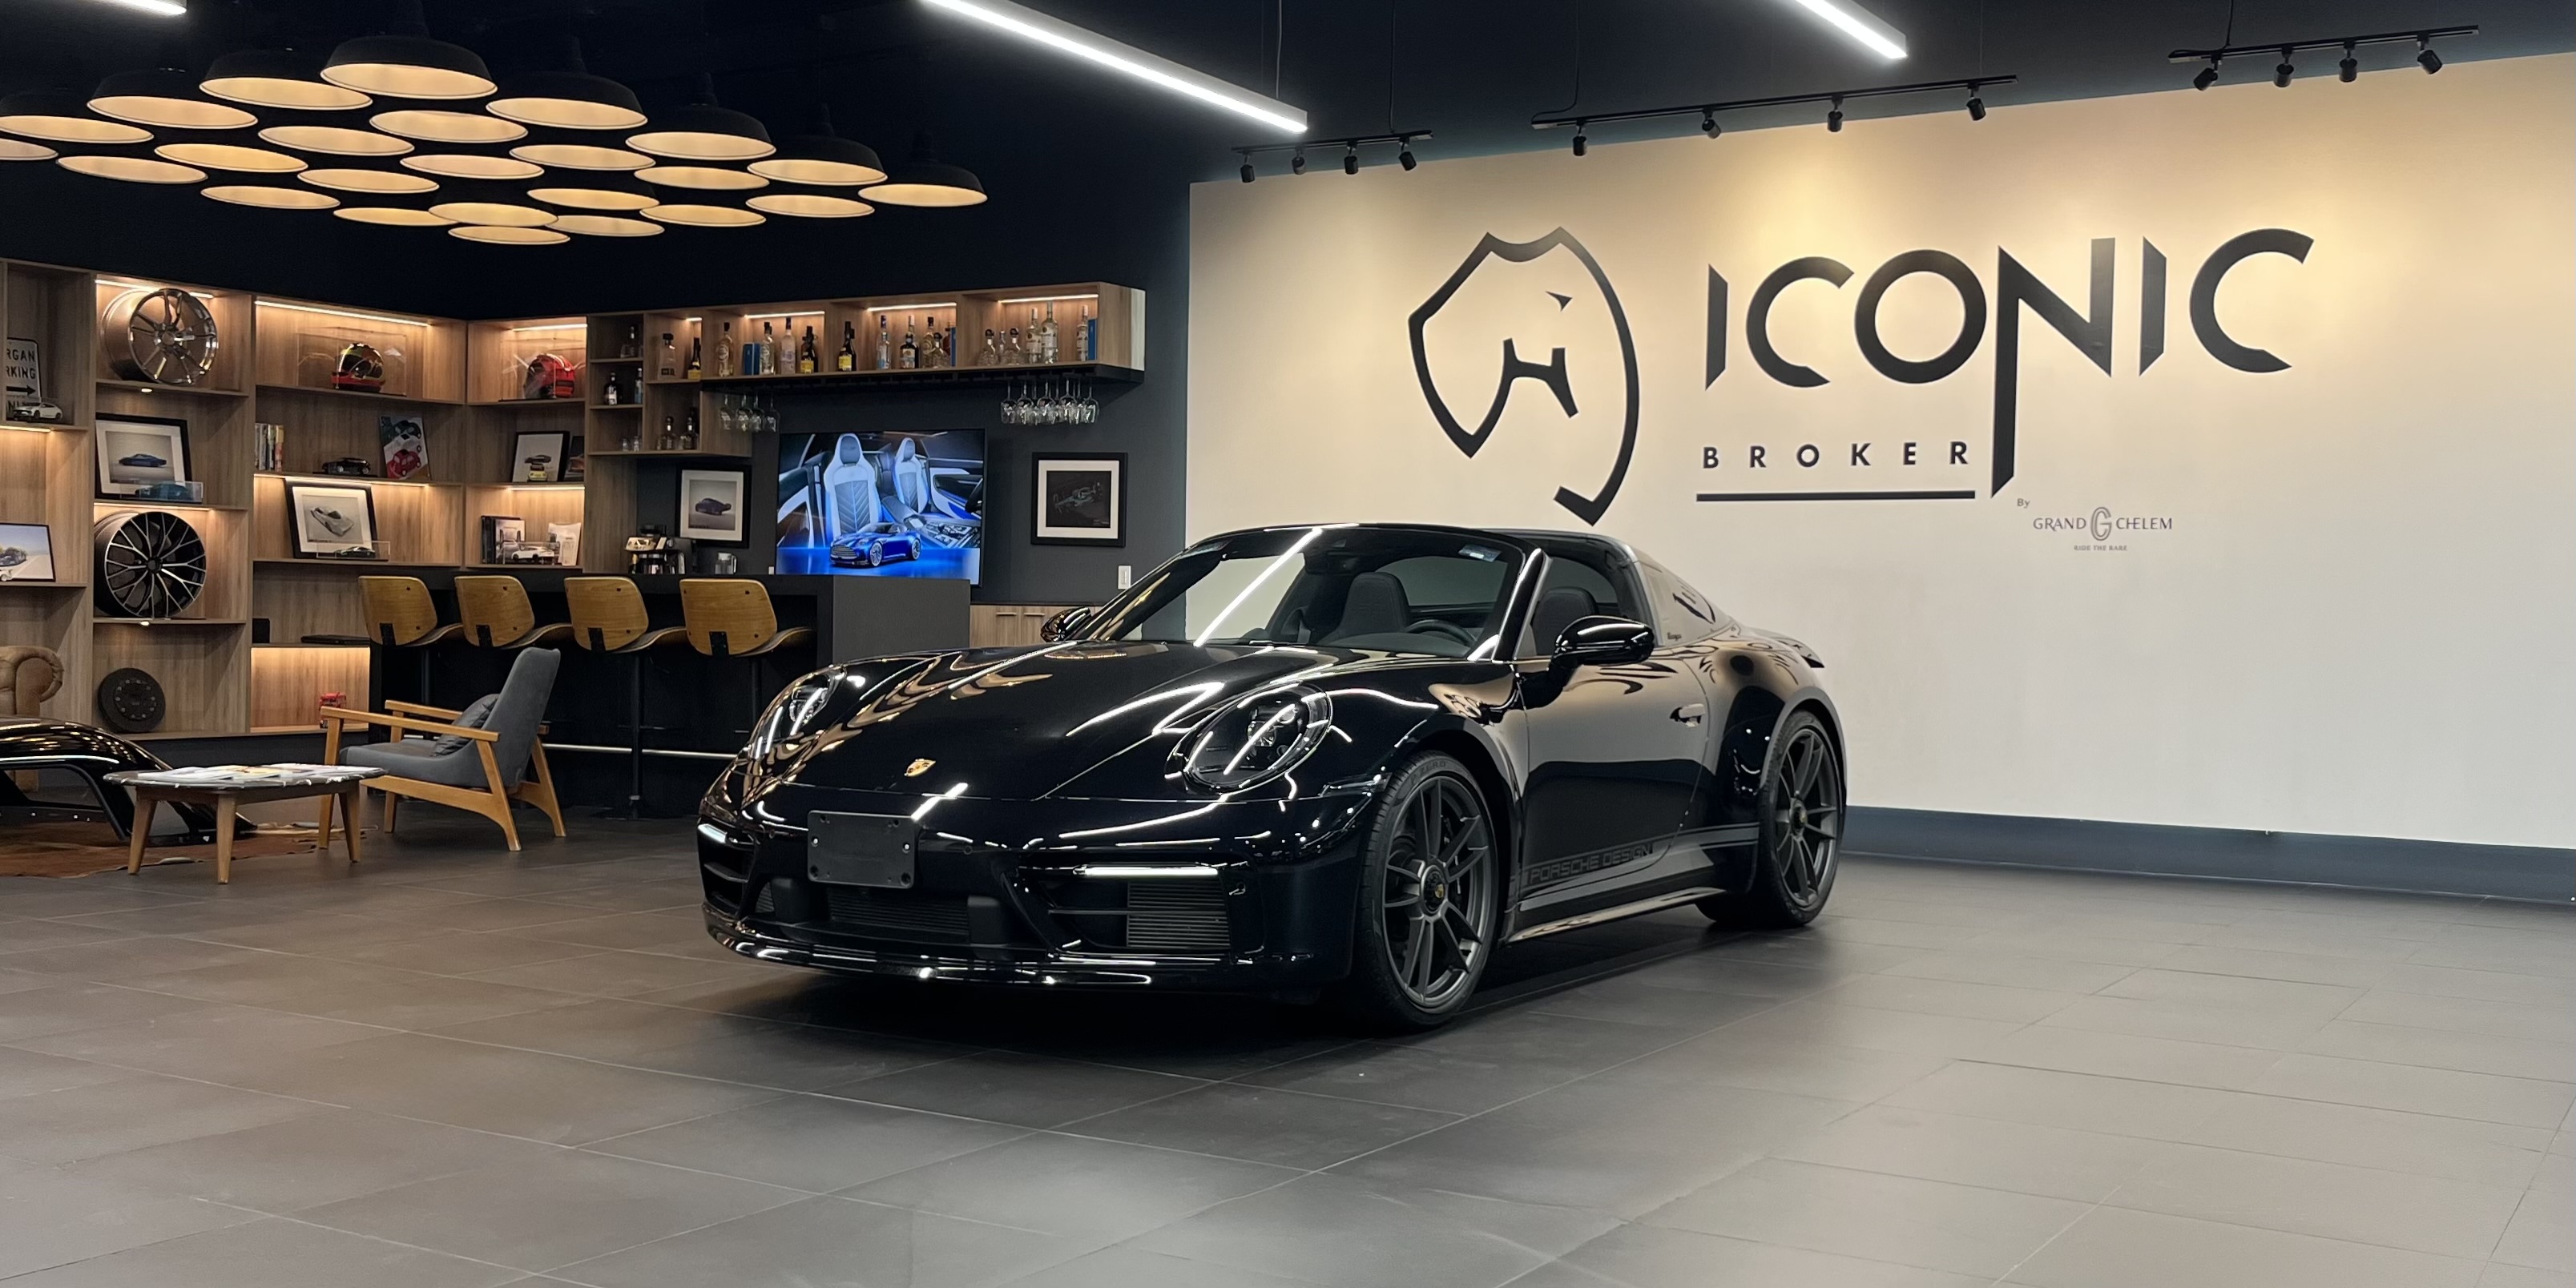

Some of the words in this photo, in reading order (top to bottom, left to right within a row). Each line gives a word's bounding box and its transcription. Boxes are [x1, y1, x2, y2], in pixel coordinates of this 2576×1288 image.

[1705, 228, 2314, 498] ICONIC
[1703, 441, 1968, 469] BROKER
[2017, 497, 2030, 509] By
[2033, 517, 2086, 531] GRAND
[2115, 517, 2172, 529] CHELEM
[1530, 855, 1600, 883] PORSCHE
[1602, 843, 1652, 867] DESIGN
